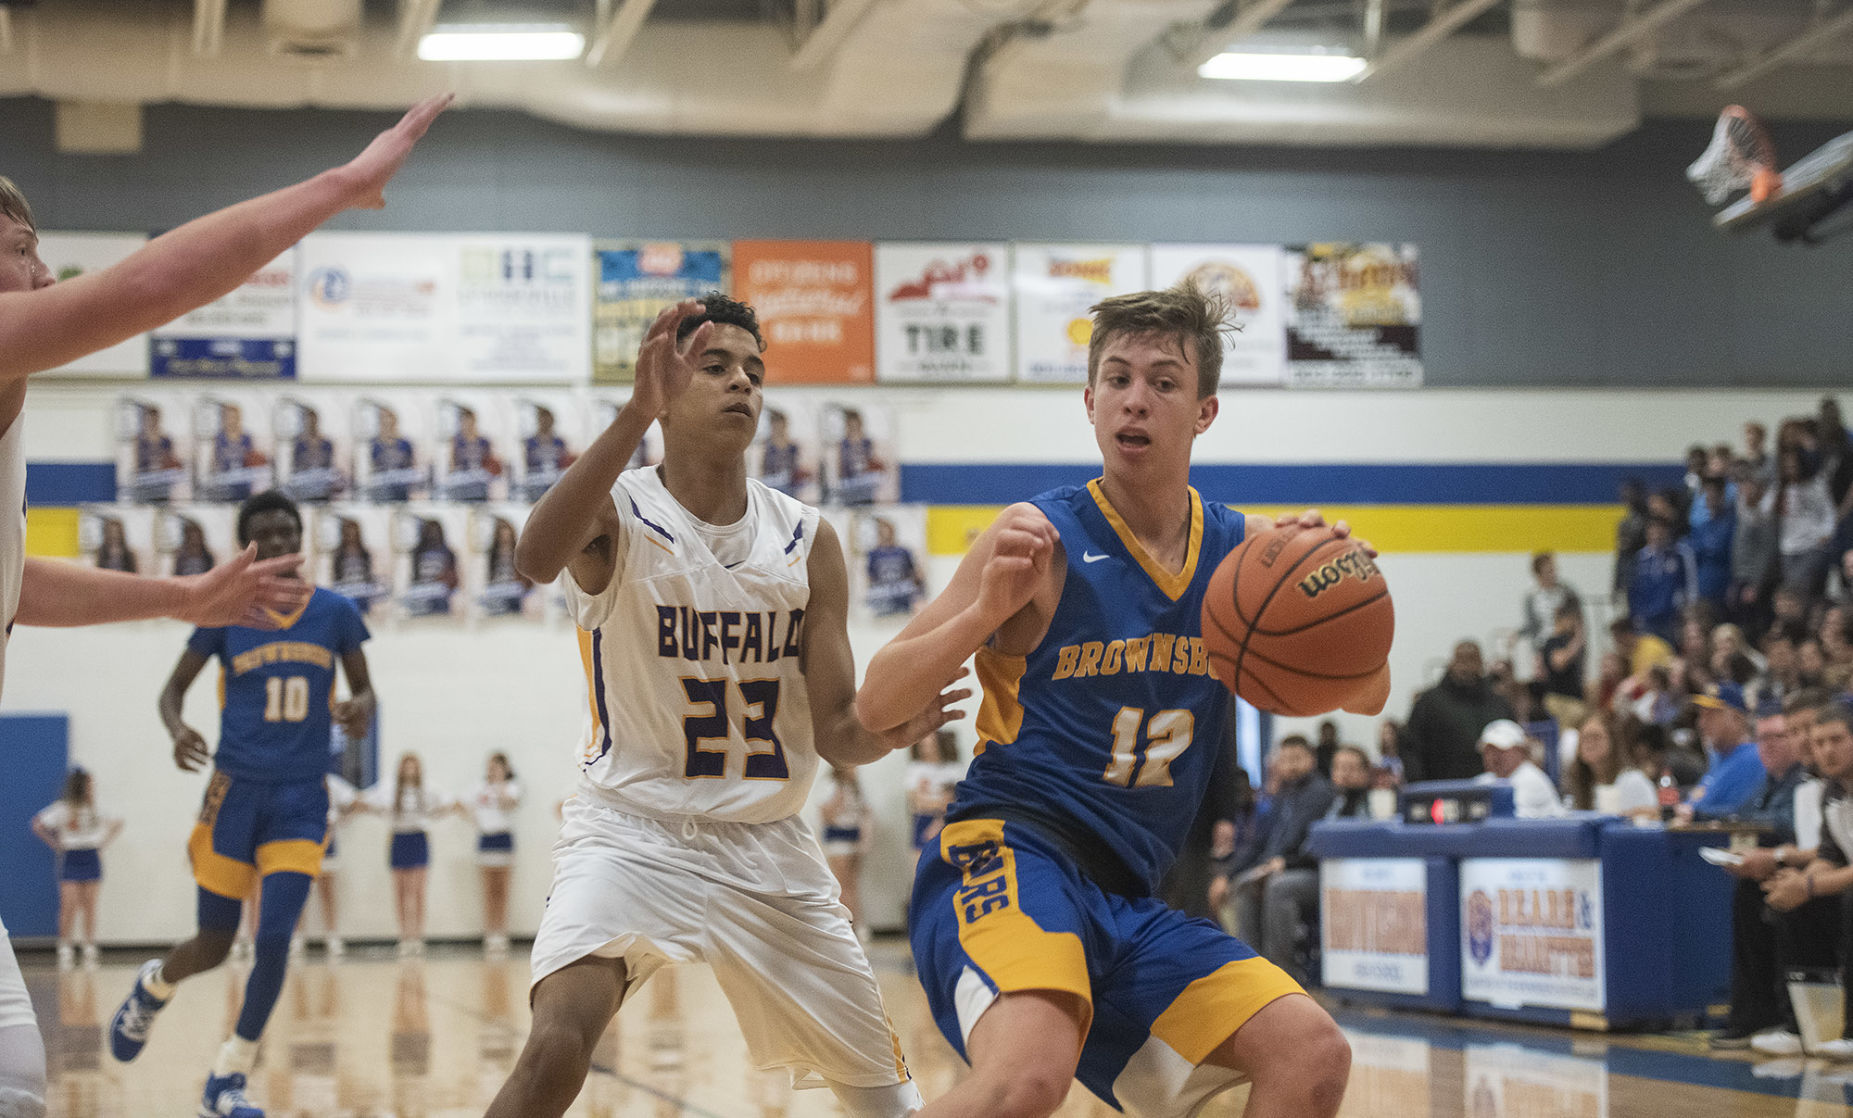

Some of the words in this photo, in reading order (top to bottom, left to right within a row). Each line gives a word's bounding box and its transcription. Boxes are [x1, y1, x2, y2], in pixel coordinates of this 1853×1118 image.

[905, 323, 984, 355] TIRE
[263, 676, 309, 722] 10
[678, 675, 791, 781] 23
[1102, 706, 1196, 788] 12
